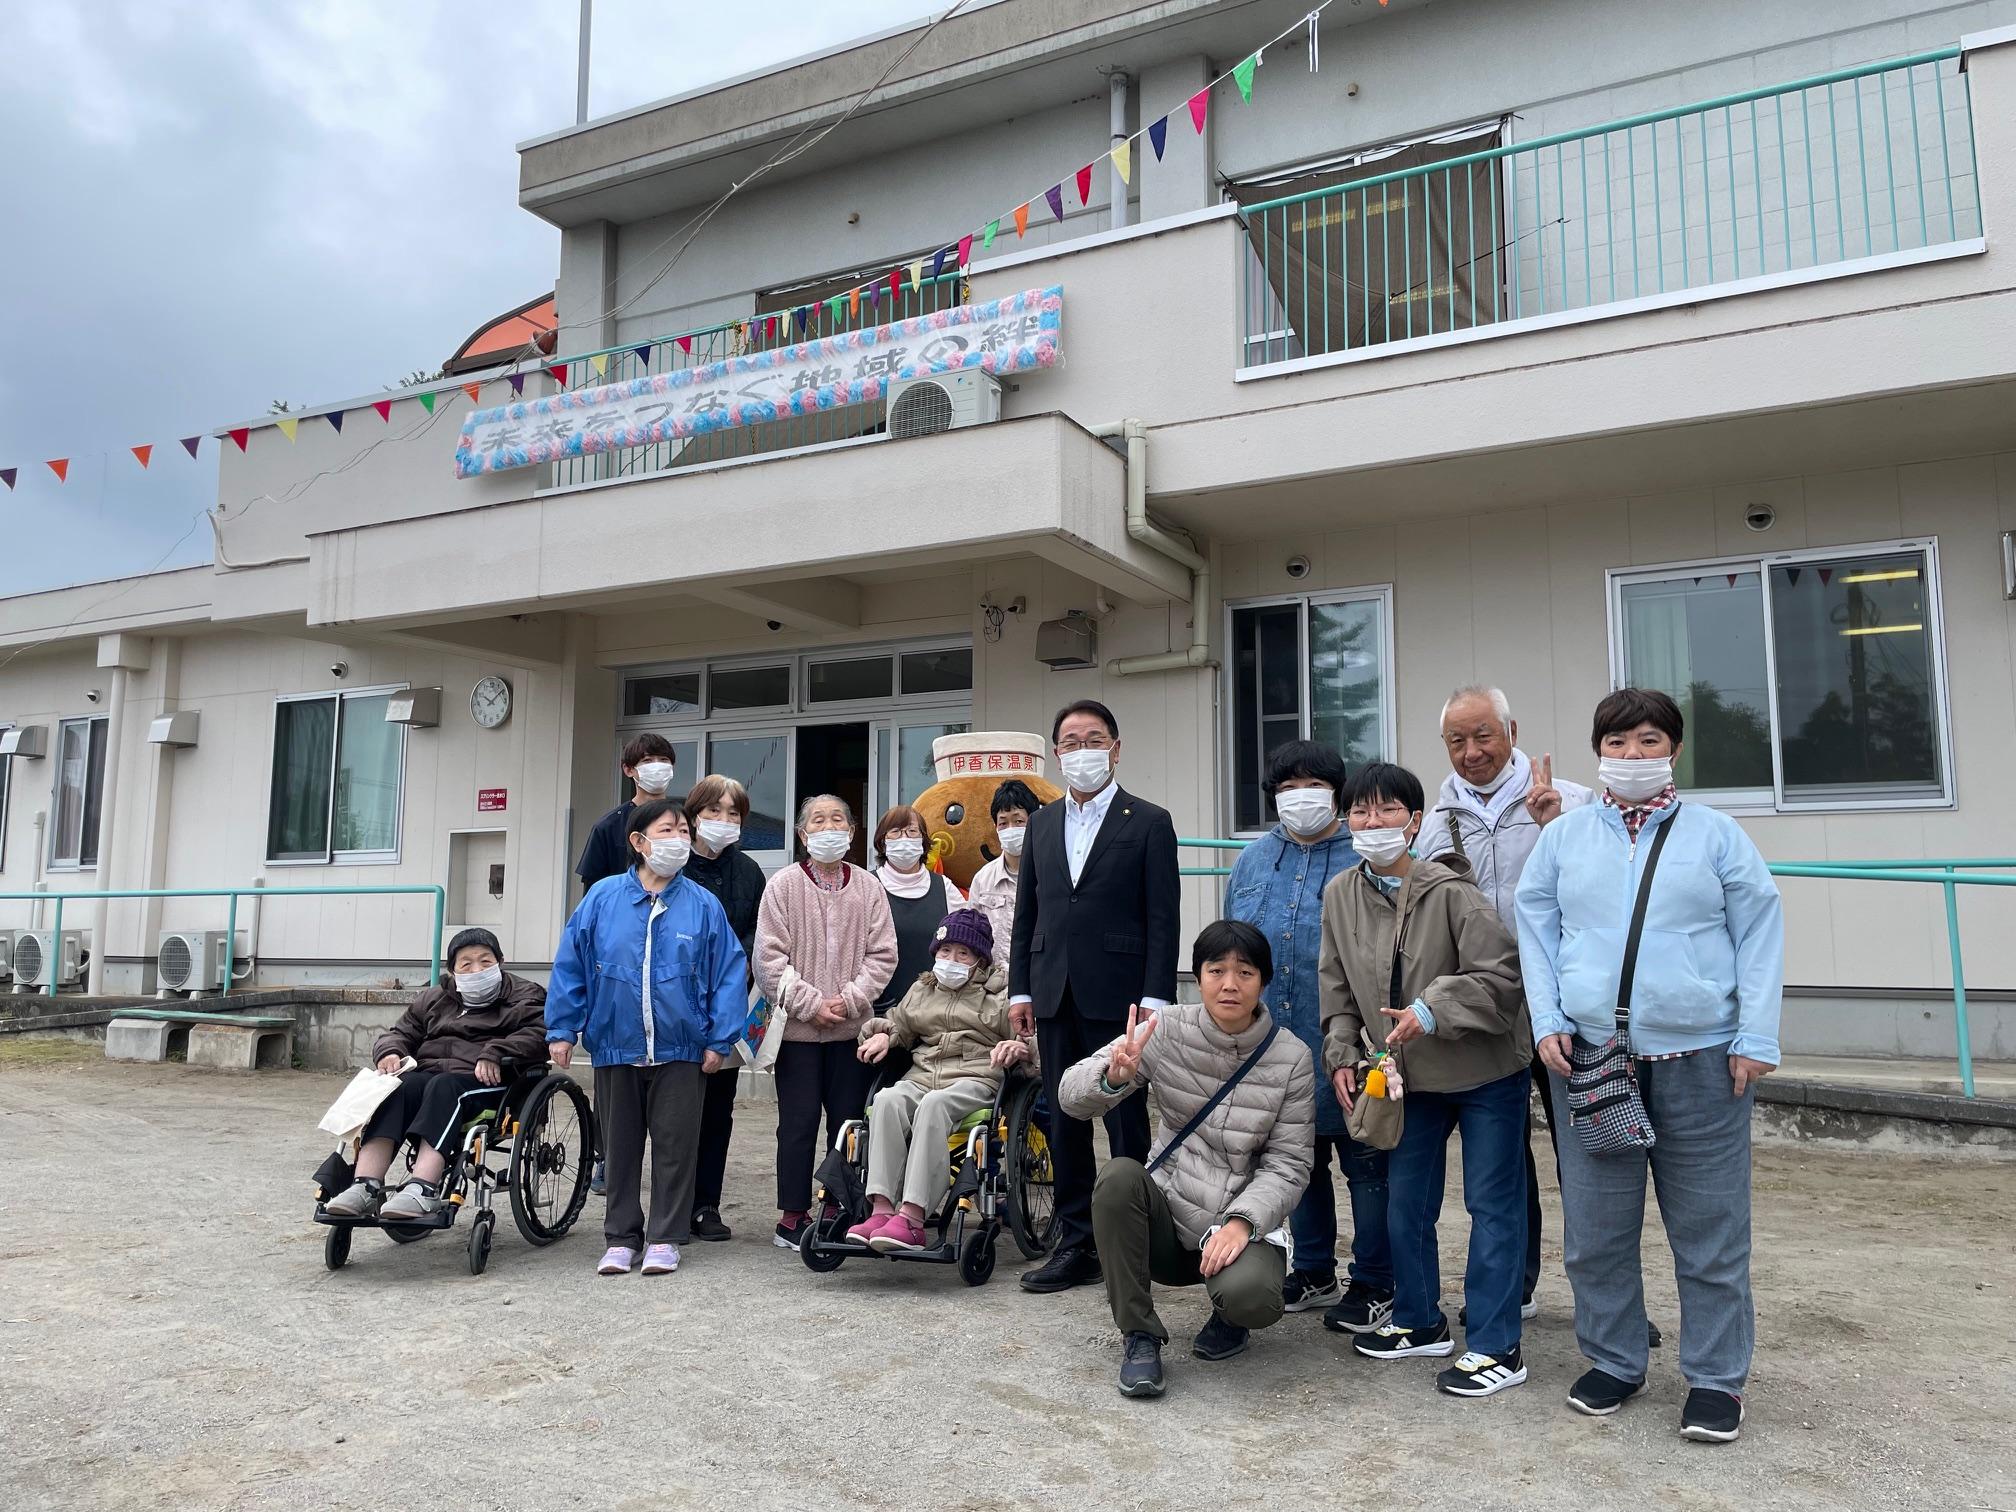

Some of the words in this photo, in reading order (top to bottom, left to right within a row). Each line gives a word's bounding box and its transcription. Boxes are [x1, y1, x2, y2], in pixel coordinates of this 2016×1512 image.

[480, 315, 1041, 454] 未来をつなぐ地域の絆
[953, 754, 1034, 771] 伊香保温泉
